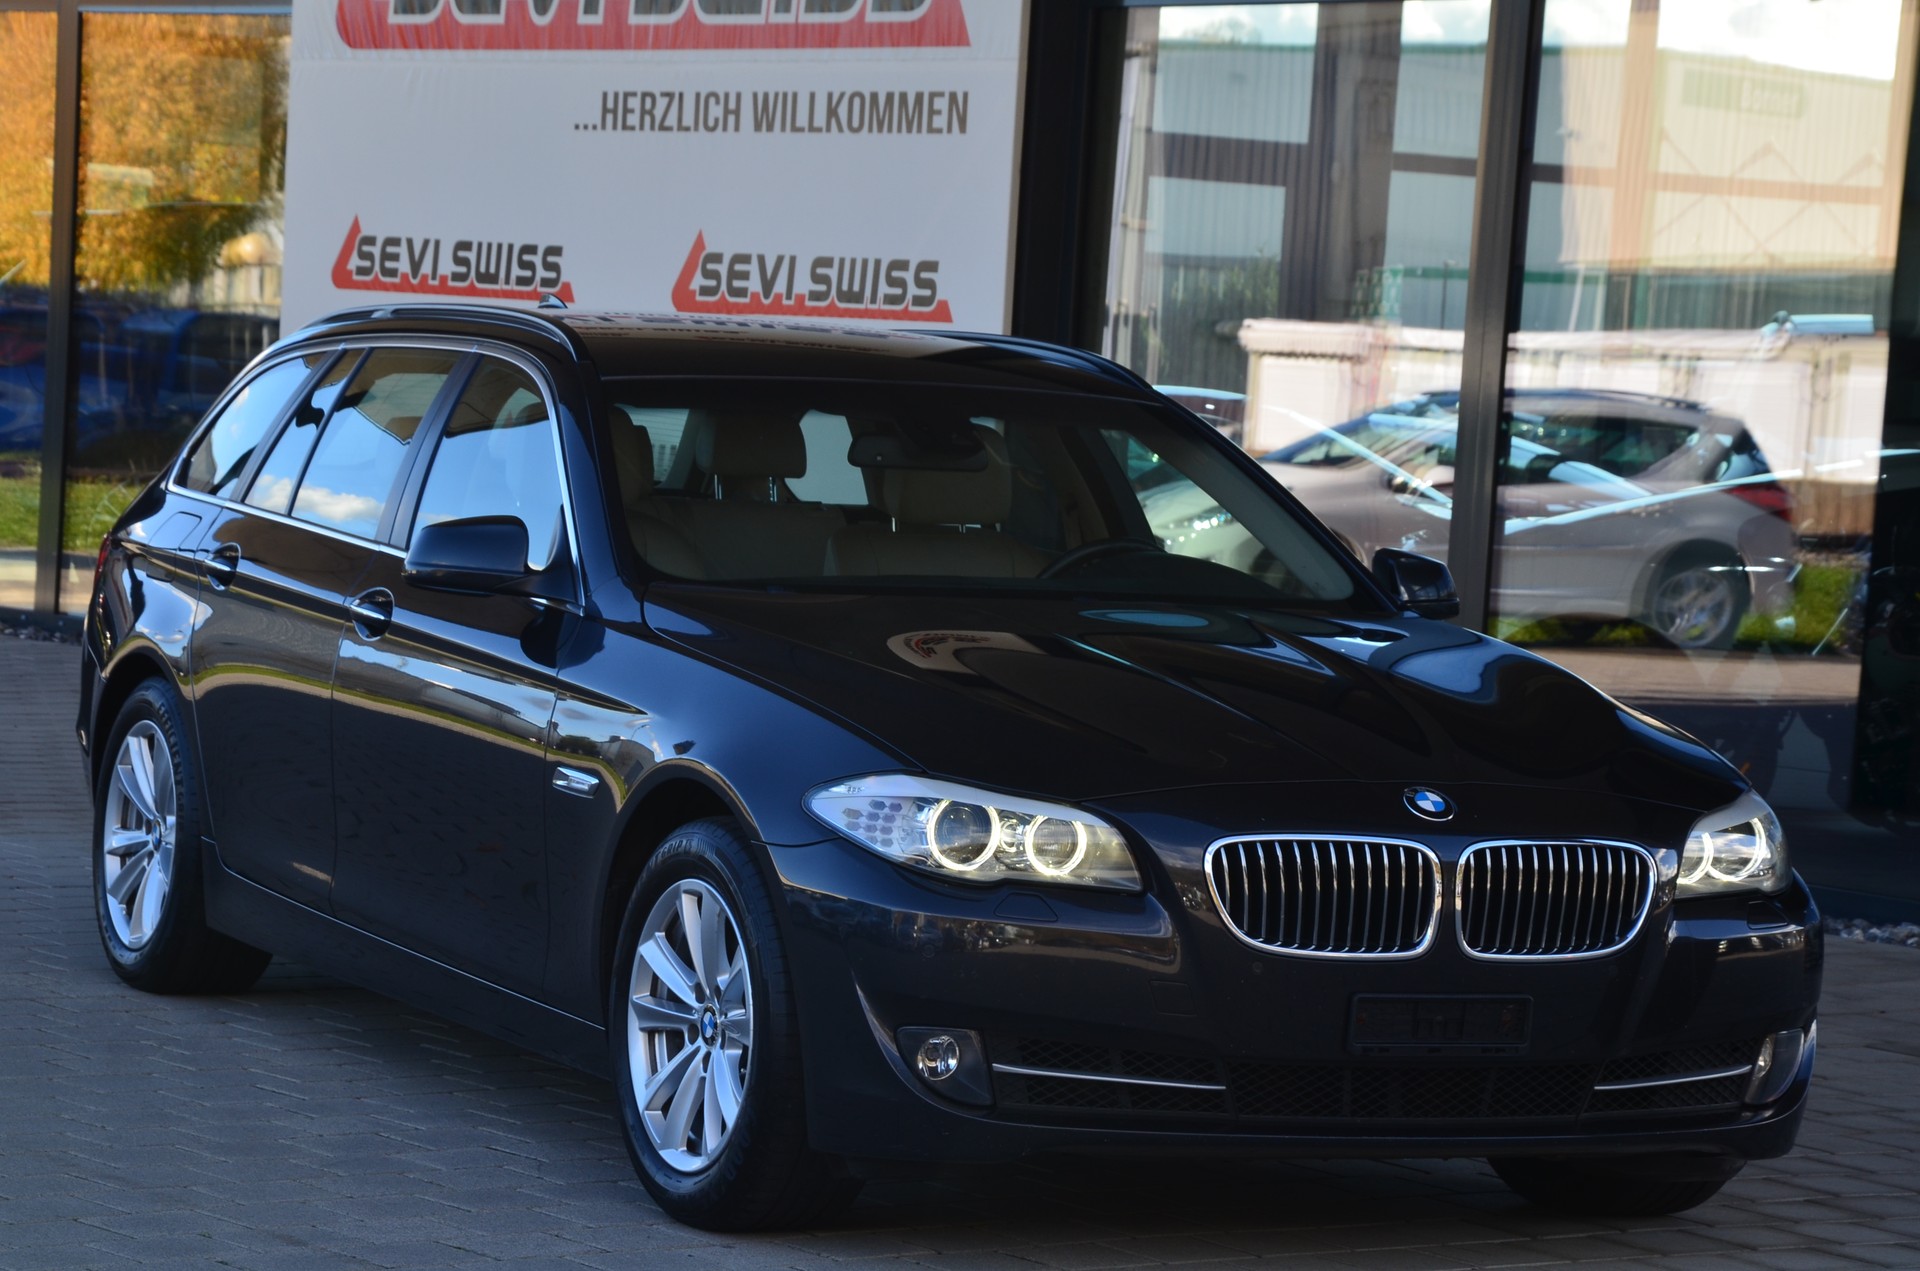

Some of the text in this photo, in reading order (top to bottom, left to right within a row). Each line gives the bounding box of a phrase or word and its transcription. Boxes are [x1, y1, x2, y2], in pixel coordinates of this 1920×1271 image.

[573, 91, 969, 134] ...HERZLICH WILLKOMMEN
[355, 235, 563, 288] SEVI SWISS
[698, 252, 939, 307] SEVI SWISS
